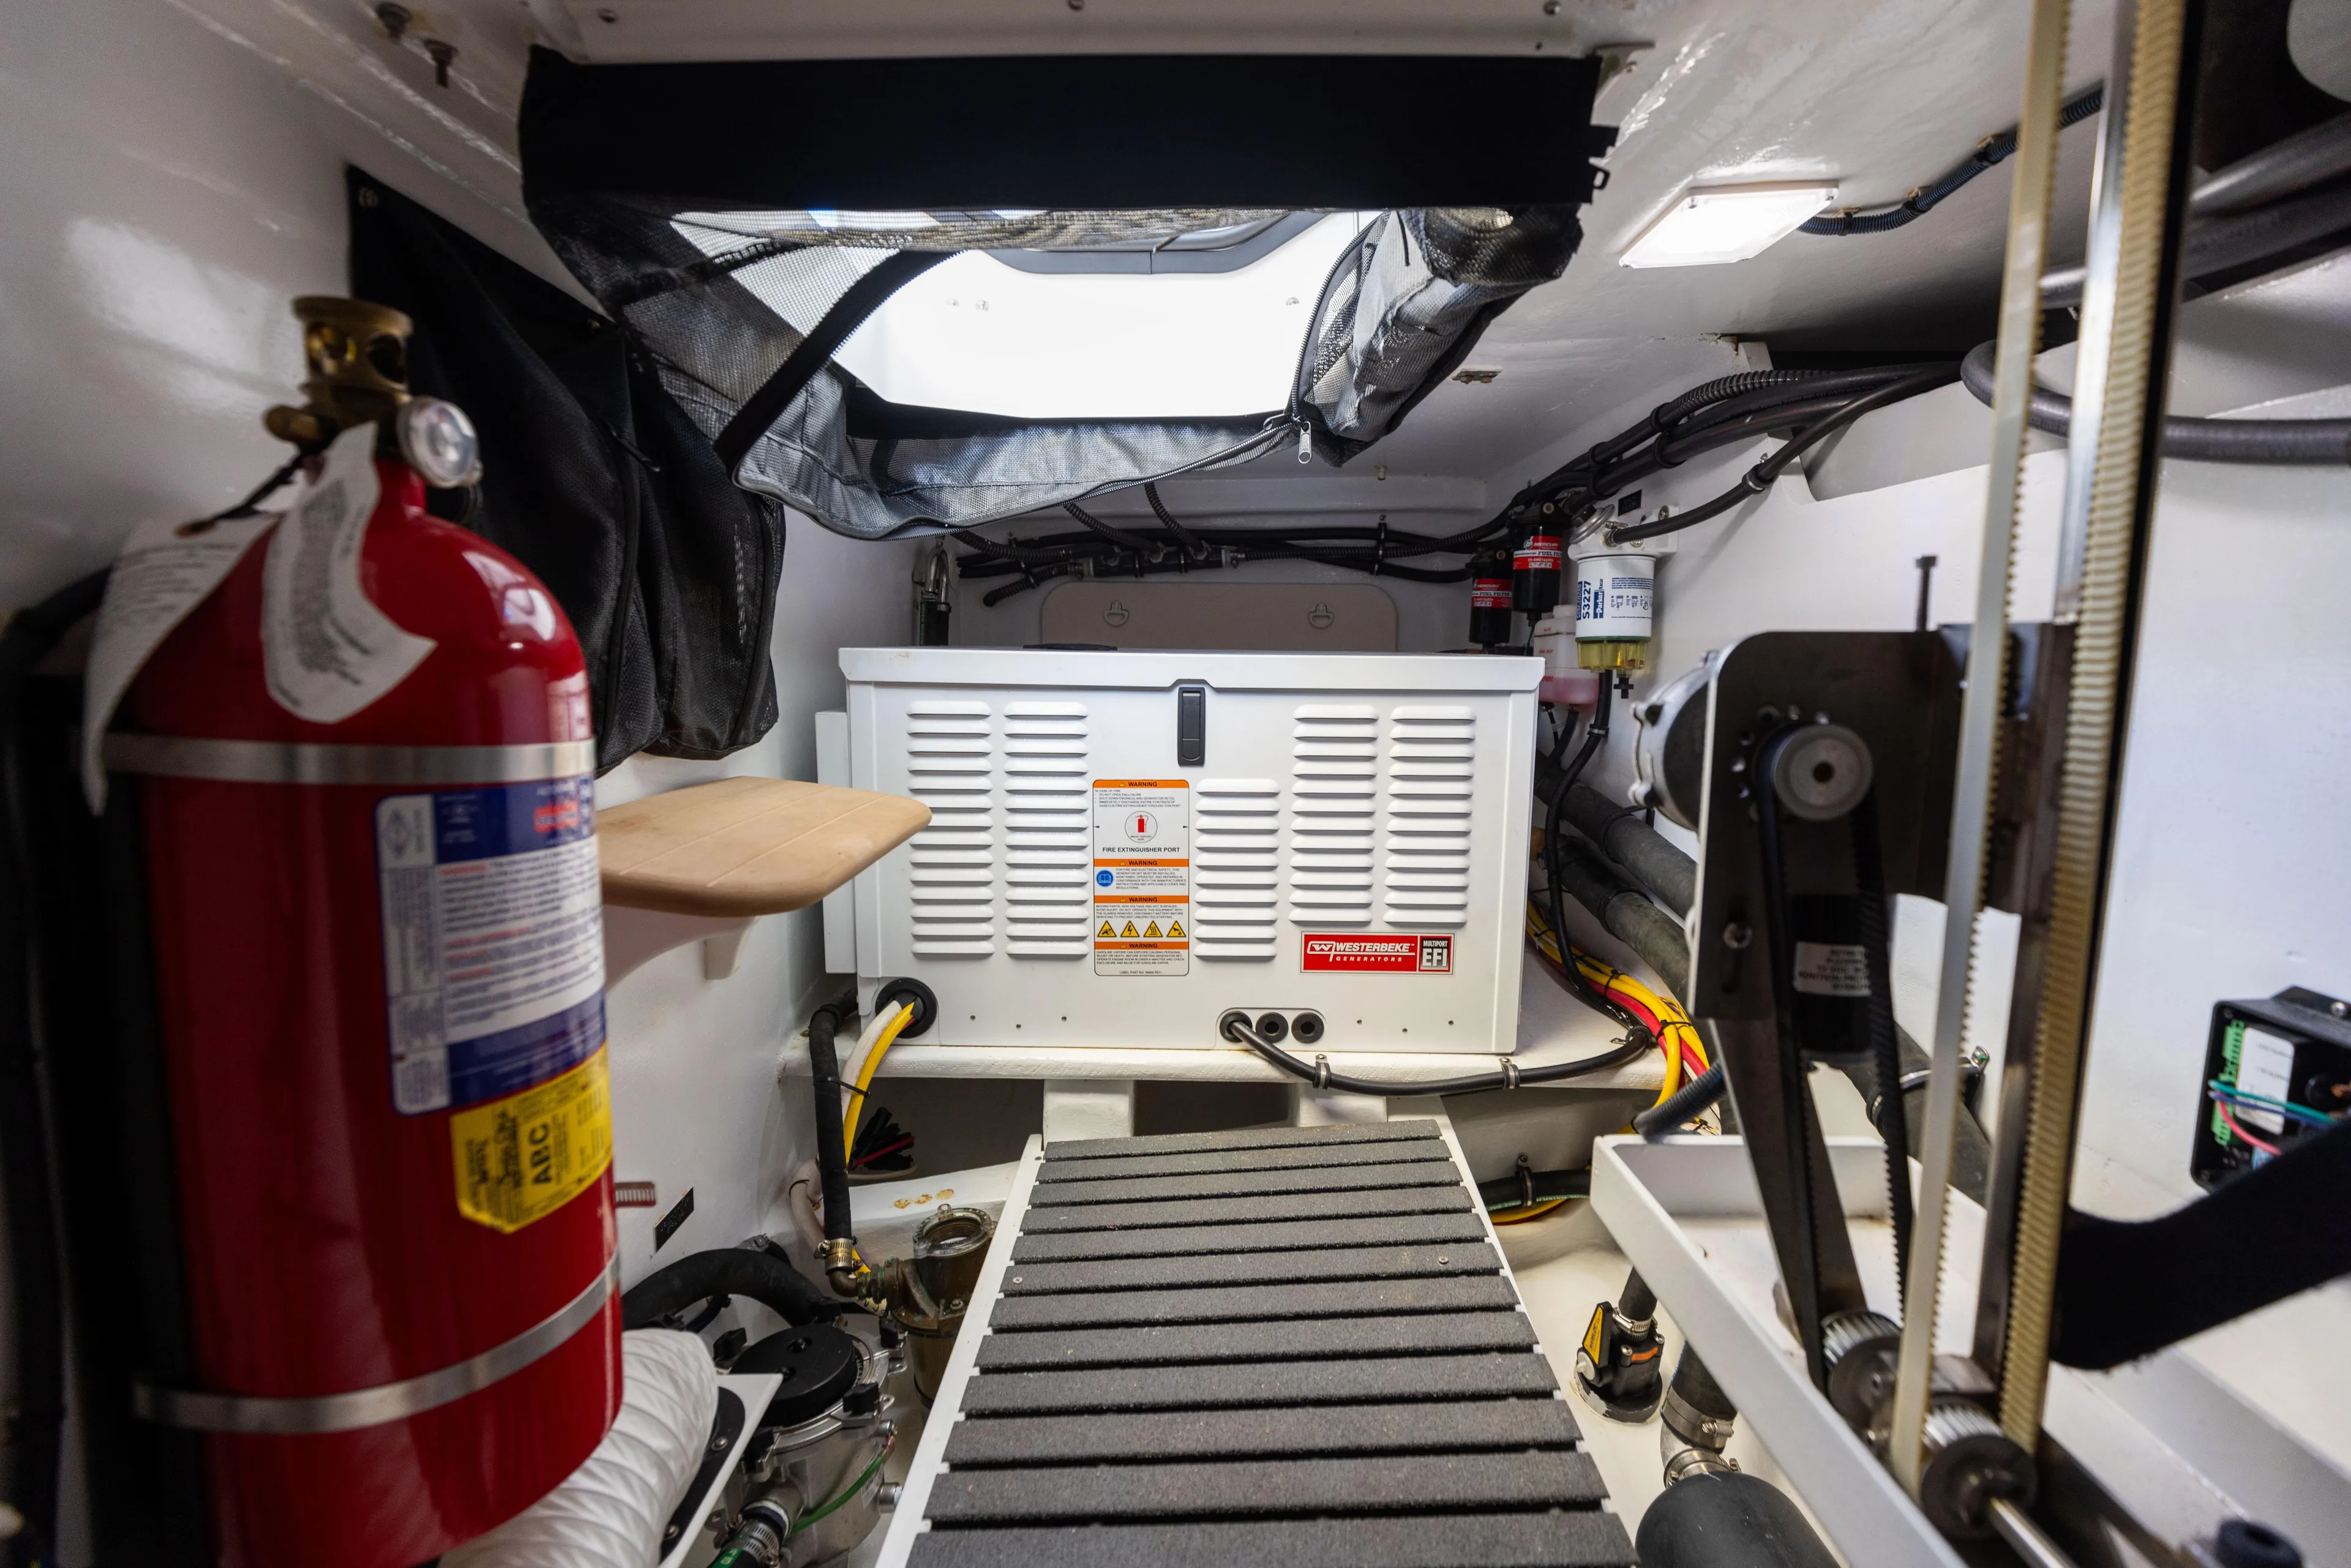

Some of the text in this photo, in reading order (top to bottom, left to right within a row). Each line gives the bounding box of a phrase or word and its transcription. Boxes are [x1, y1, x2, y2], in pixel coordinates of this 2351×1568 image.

[1583, 581, 1591, 619] S3227
[1336, 943, 1410, 952] WESTERBEKE
[1422, 948, 1448, 967] EFI
[528, 1123, 552, 1184] ABC
